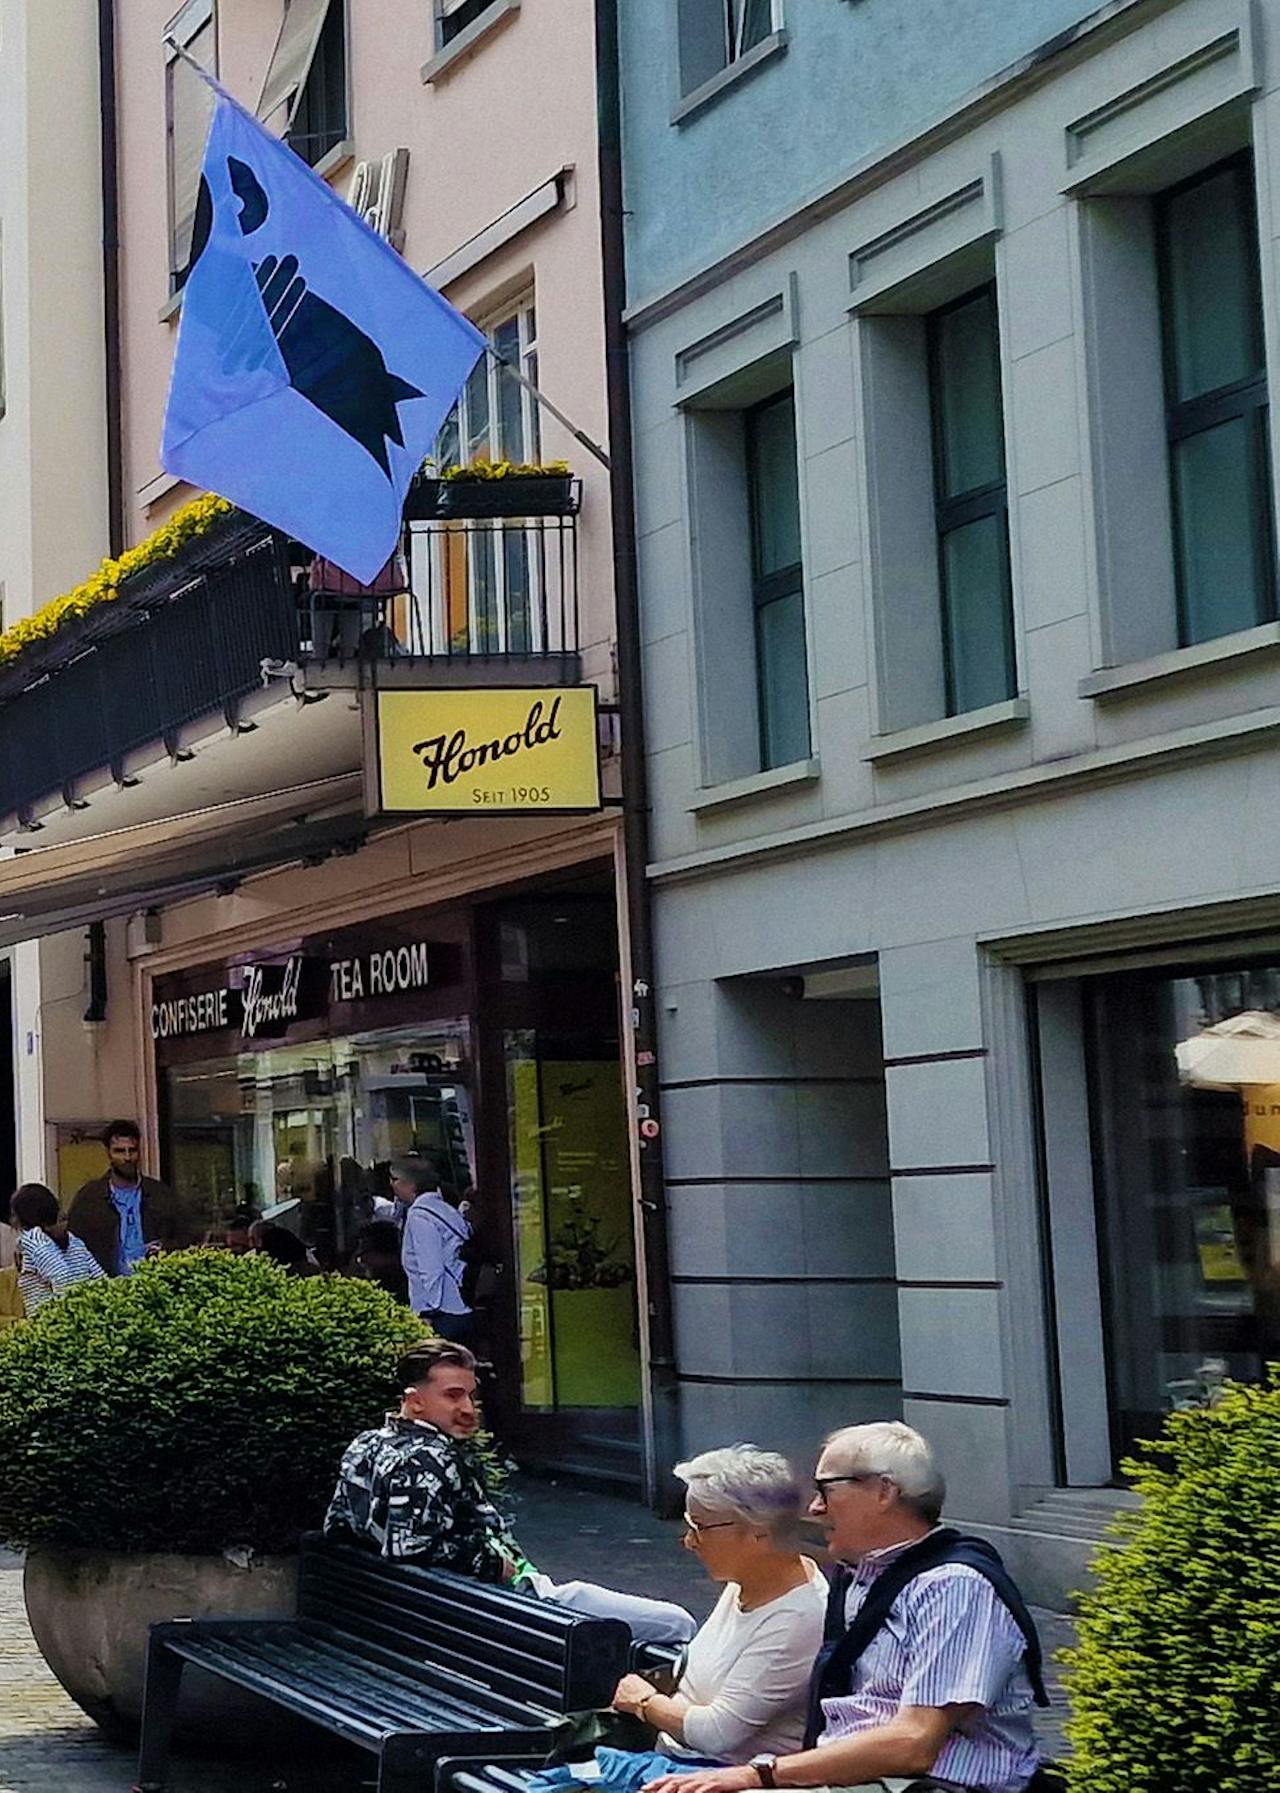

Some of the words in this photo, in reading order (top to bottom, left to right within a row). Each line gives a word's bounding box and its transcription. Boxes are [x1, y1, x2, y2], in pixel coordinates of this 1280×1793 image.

[412, 695, 562, 790] Honold
[472, 788, 505, 804] SEIT
[512, 787, 551, 803] 1905
[150, 988, 229, 1040] CONFISERIE
[241, 955, 303, 1039] Honold
[330, 958, 364, 1002] TEA
[370, 942, 429, 996] ROOM
